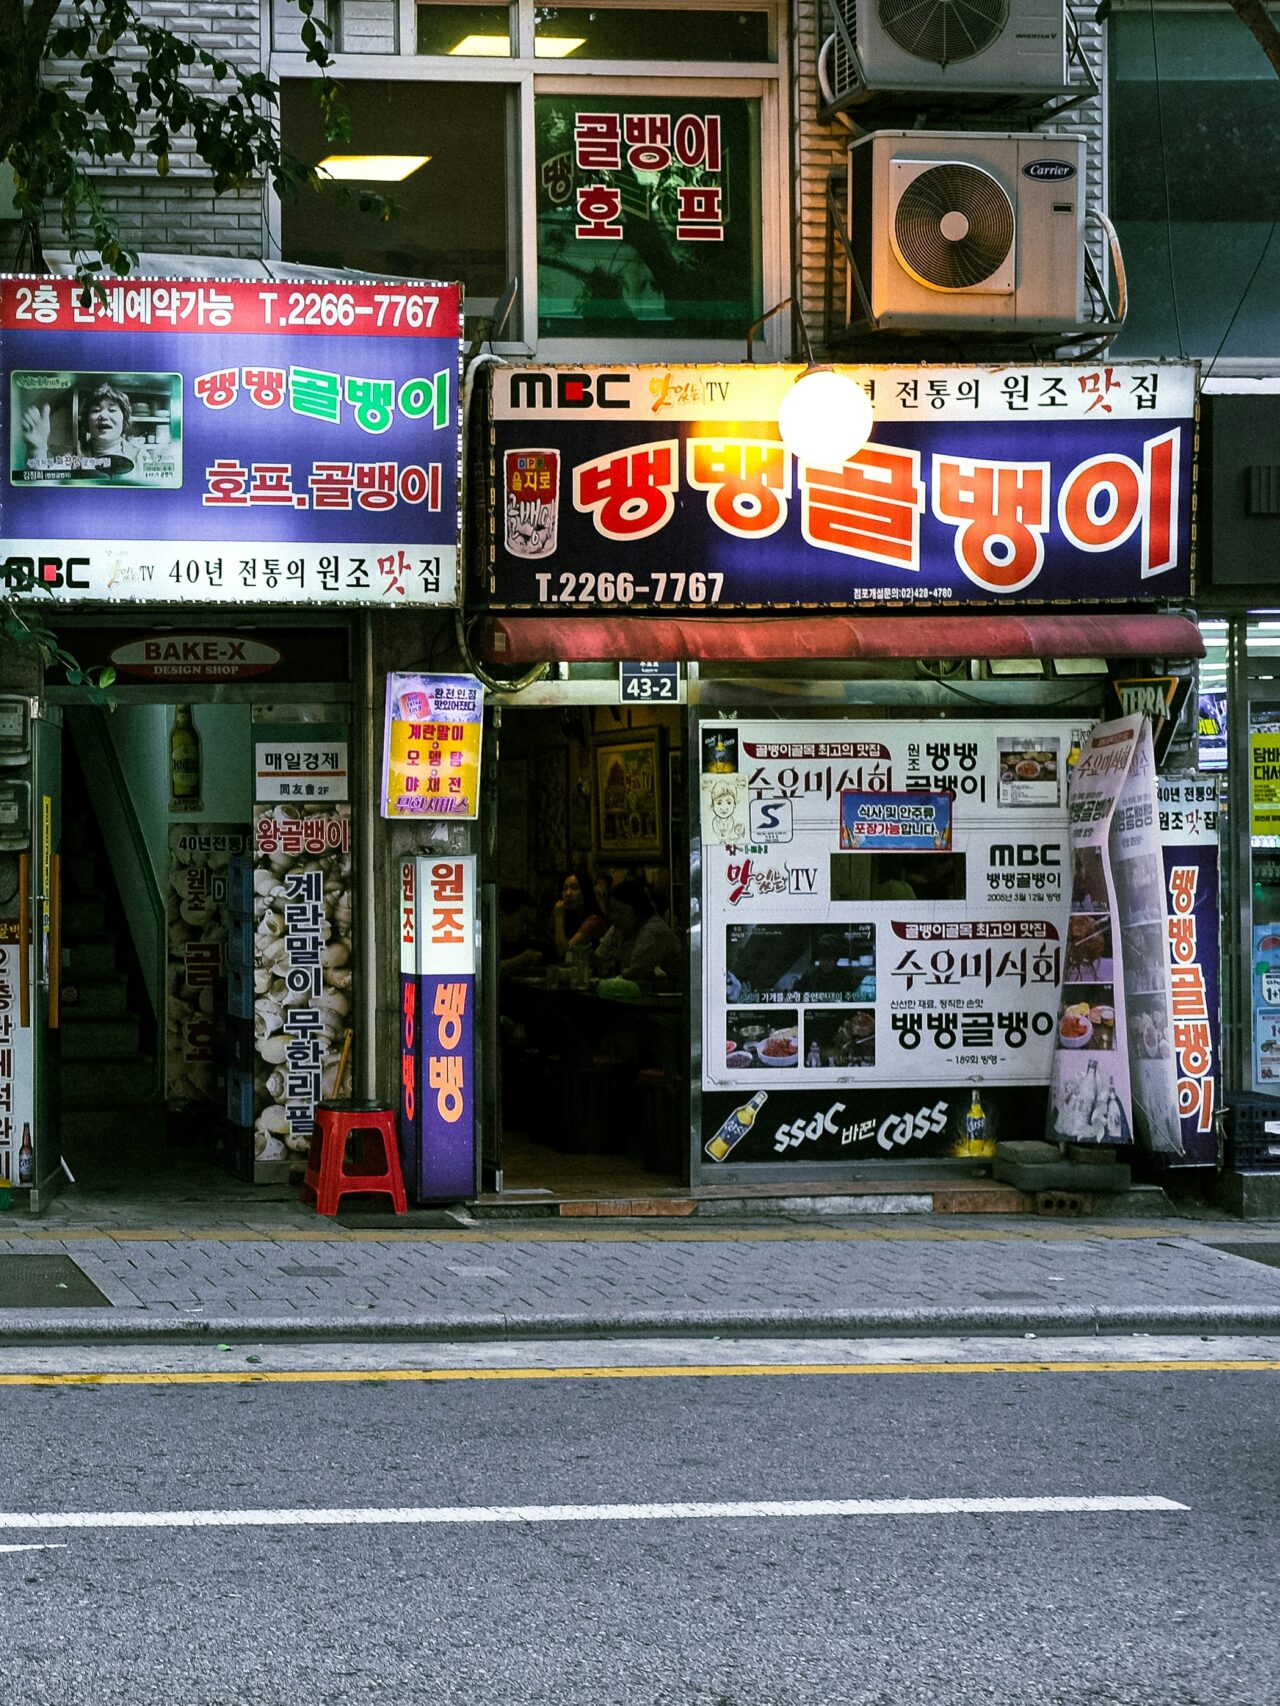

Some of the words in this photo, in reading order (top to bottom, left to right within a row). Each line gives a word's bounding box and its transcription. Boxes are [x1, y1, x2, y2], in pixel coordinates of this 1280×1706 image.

[574, 112, 722, 173] 골뱅이
[1028, 162, 1073, 179] Carrier
[15, 285, 61, 322] 2층
[70, 285, 234, 326] 단체예약가능
[259, 292, 440, 329] T.2266-7767
[510, 372, 631, 409] MBC
[706, 381, 730, 403] TV
[896, 378, 981, 411] 전통의
[1001, 376, 1070, 411] 원조
[512, 472, 551, 491] 을지로
[573, 427, 1181, 593] 뱅뱅골뱅이
[5, 556, 90, 589] MBC
[168, 558, 225, 589] 40년
[239, 557, 306, 589] 전통의
[535, 572, 725, 603] T.2266-7767
[144, 642, 247, 661] BAKE-X
[153, 665, 202, 675] DESIGN
[205, 665, 239, 675] SHOP
[626, 677, 672, 698] 43-2
[408, 723, 464, 741] 계란말이
[264, 752, 340, 771] 매일경제
[818, 743, 854, 758] 최고의
[856, 743, 881, 758] 맛집
[907, 743, 920, 771] 원조
[926, 743, 978, 771] 뱅뱅
[317, 785, 330, 796] 2F
[1157, 786, 1181, 802] 40년
[858, 805, 883, 819] 식사
[256, 818, 350, 854] 왕골뱅이
[989, 844, 1061, 867] MBC
[791, 868, 819, 892] TV
[986, 872, 1061, 889] 뱅뱅골뱅이
[431, 863, 465, 944] 원조
[284, 871, 324, 999] 계란말이
[976, 921, 1016, 938] 최고의
[1020, 921, 1047, 938] 맛집
[890, 942, 1061, 991] 수요미식회
[429, 982, 468, 1124] 뱅뱅
